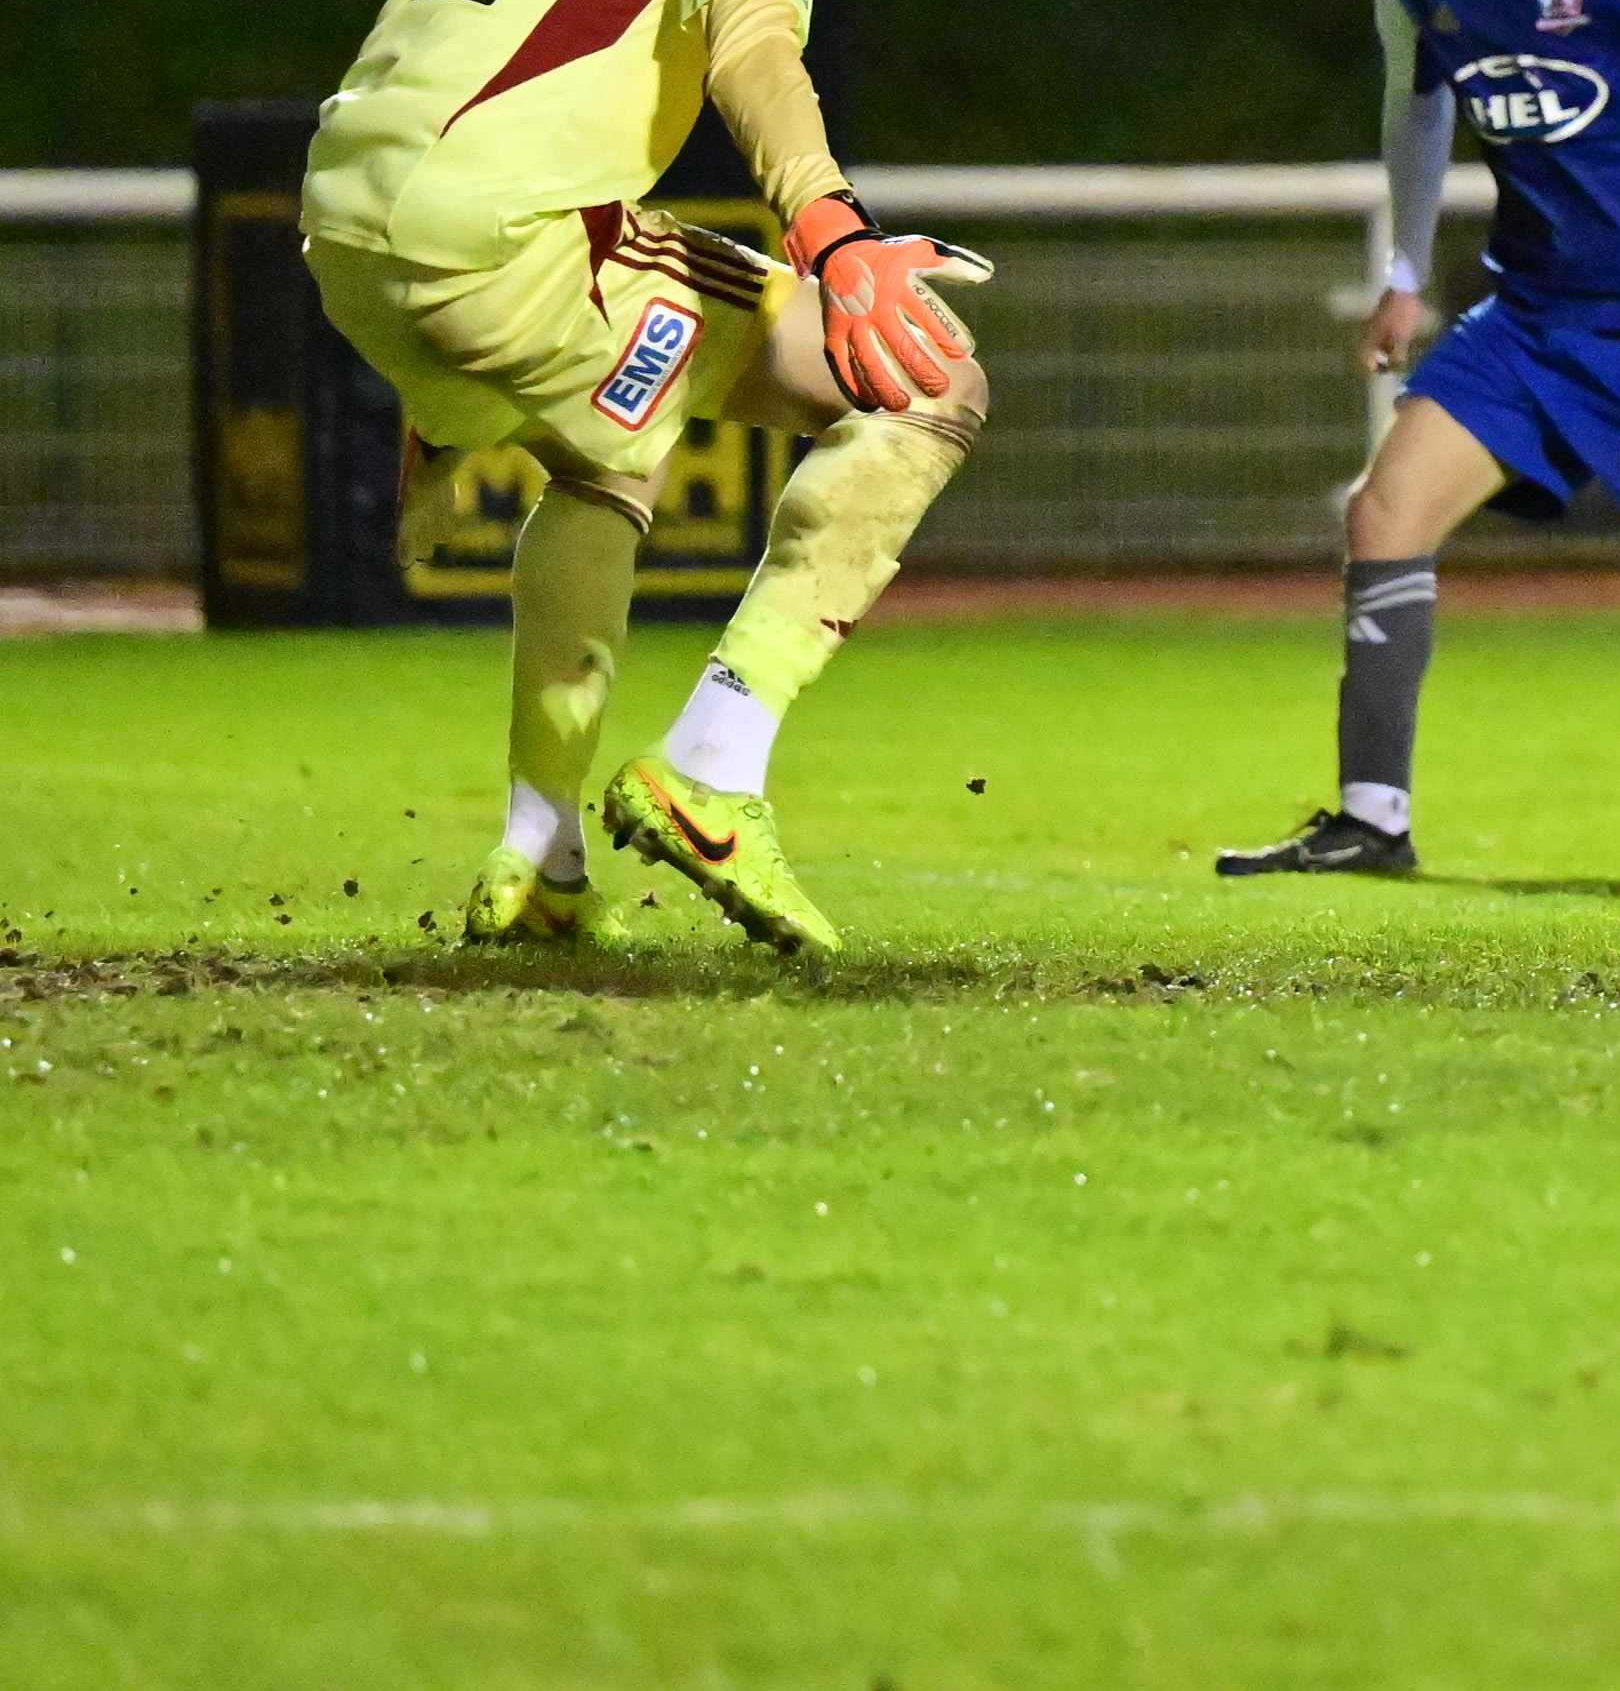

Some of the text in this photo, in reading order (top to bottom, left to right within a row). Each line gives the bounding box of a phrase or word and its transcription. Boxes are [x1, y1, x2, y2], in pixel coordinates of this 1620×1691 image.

[1470, 89, 1580, 130] HEL
[924, 297, 960, 339] SOCCER
[603, 314, 684, 413] EMS
[711, 674, 751, 697] adidas
